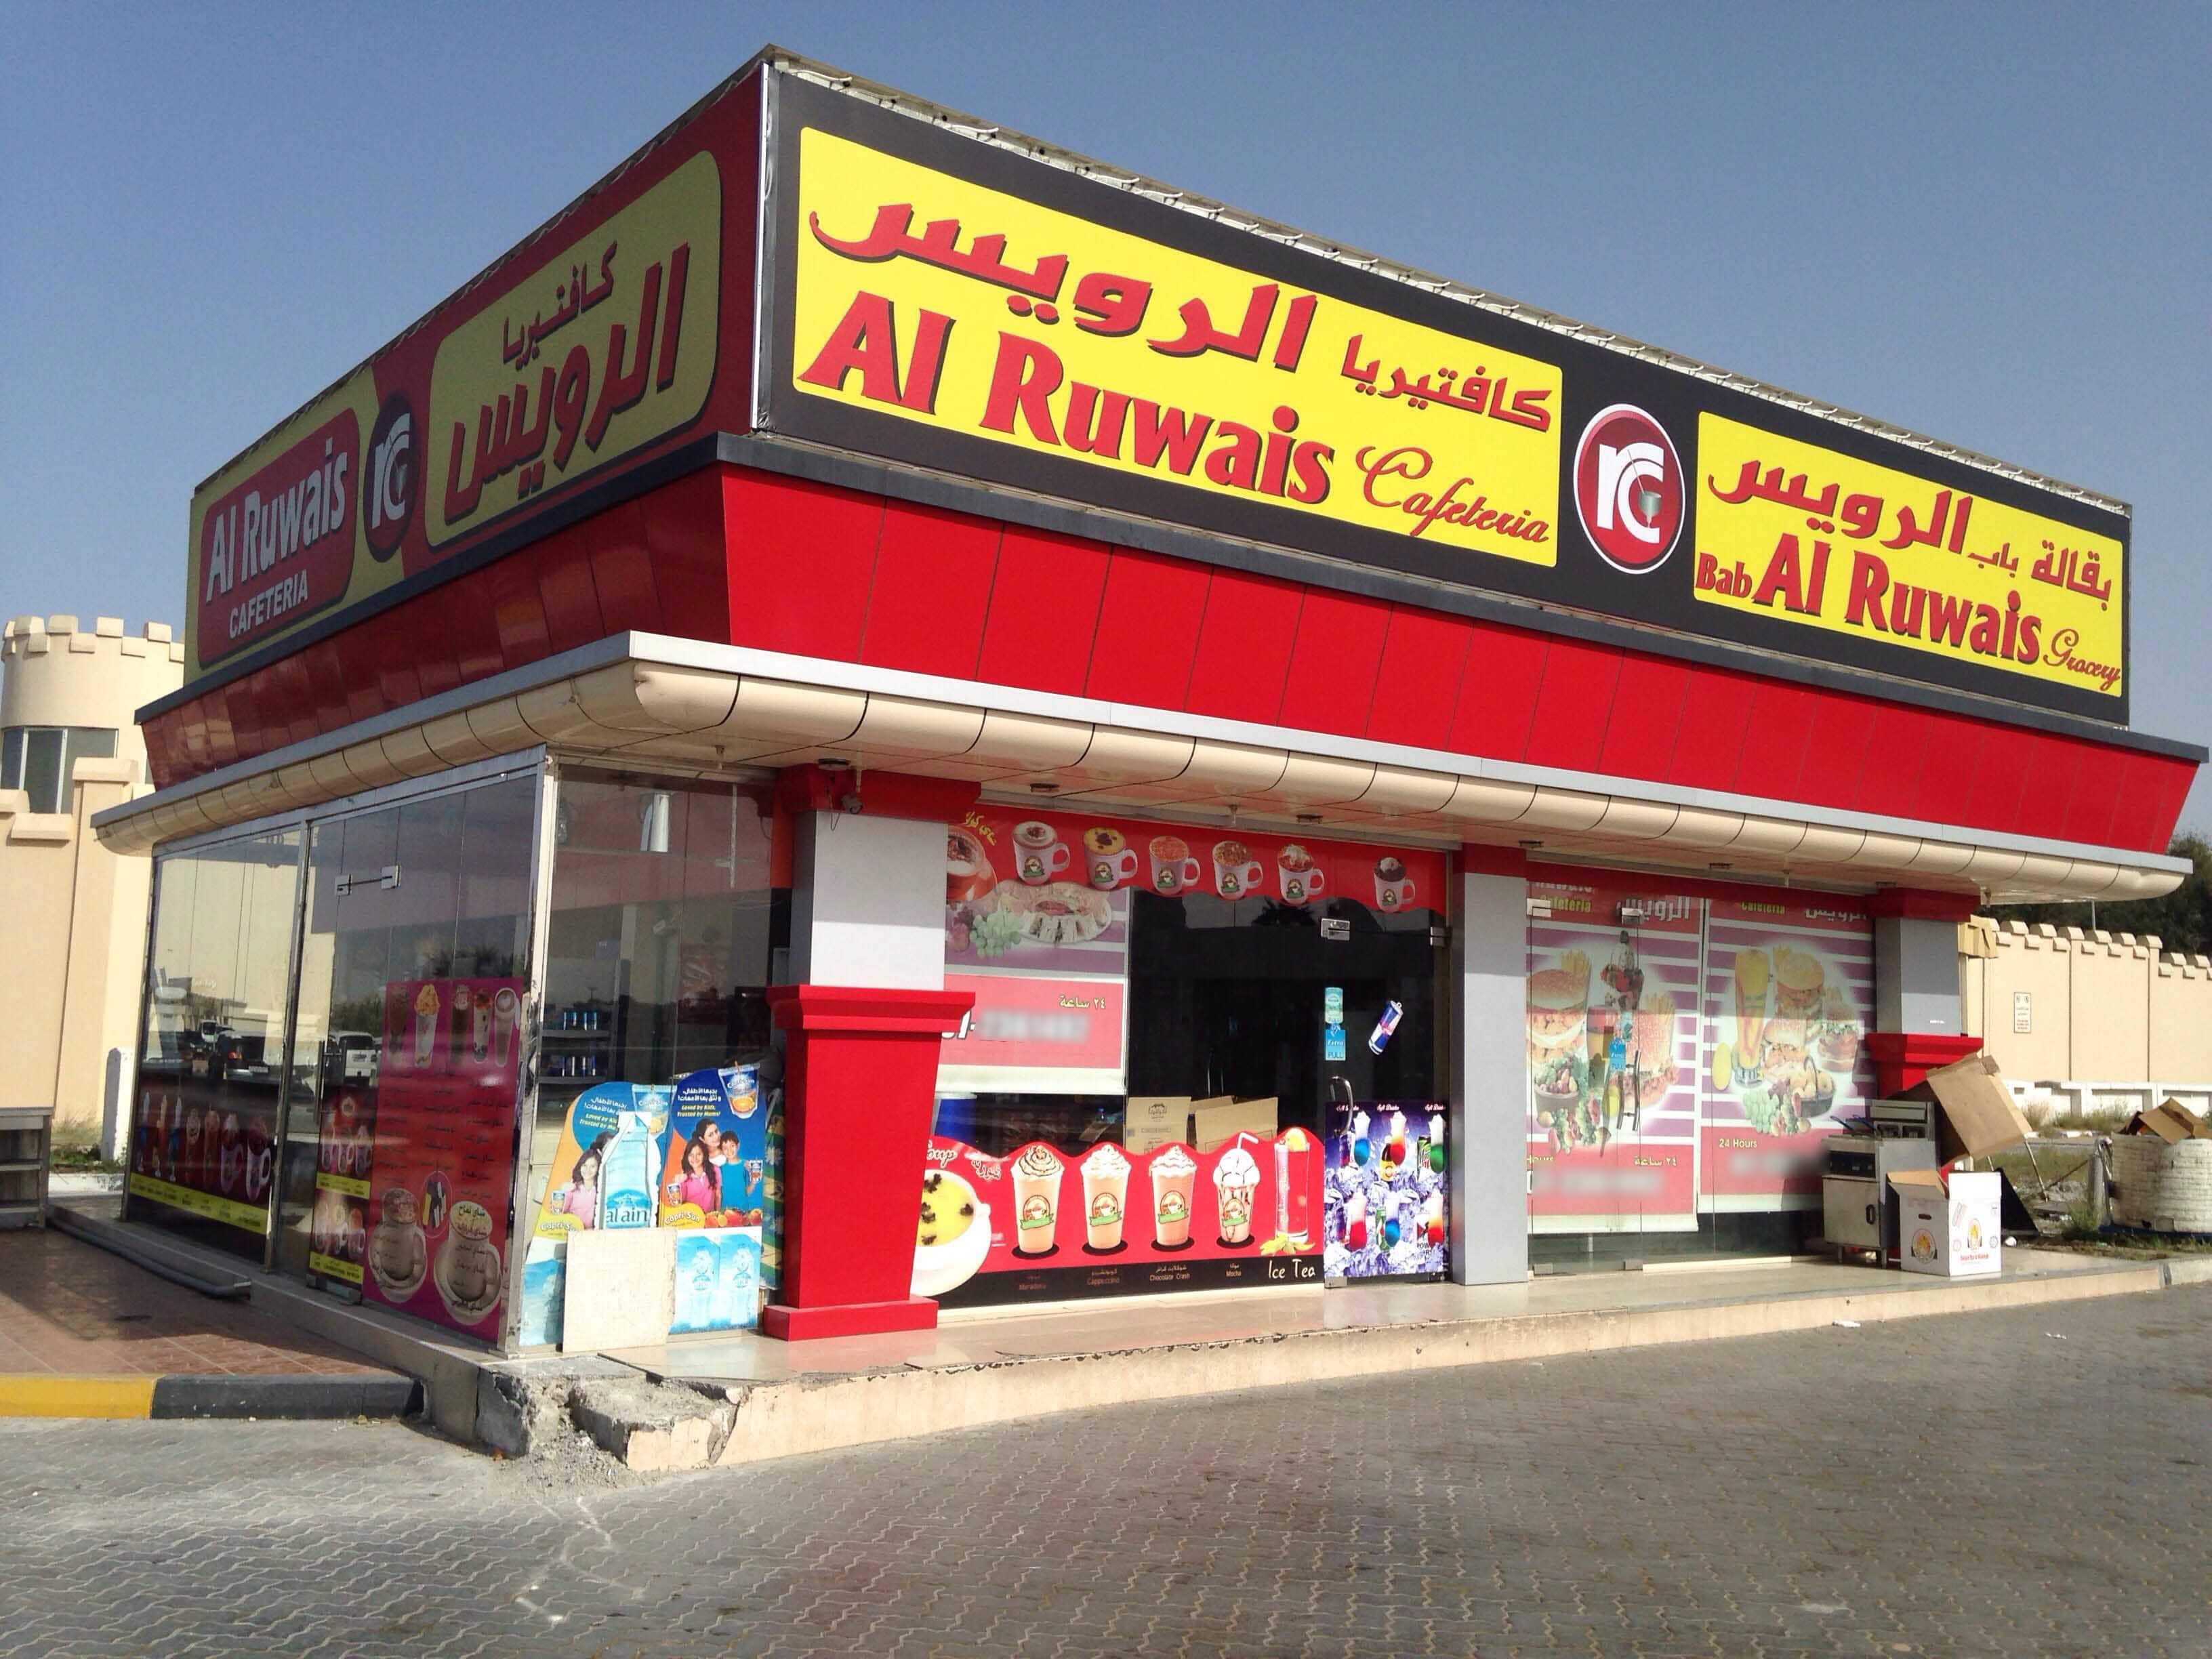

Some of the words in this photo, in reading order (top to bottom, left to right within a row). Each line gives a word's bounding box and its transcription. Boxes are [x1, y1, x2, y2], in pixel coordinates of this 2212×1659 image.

[502, 240, 617, 371] كافتيريا
[810, 203, 1317, 371] الرويس
[444, 239, 689, 526] الرويس
[797, 290, 956, 415] Al
[979, 331, 1334, 504] Ruwais
[1355, 446, 1549, 542] Cafeteria
[1341, 334, 1552, 432] كافتيريا
[206, 505, 236, 602] Al
[242, 438, 347, 583] Ruwais
[1708, 459, 1973, 554] الرويس
[229, 569, 308, 639] CAFETERIA
[1696, 552, 1752, 598] Bab
[1752, 533, 1830, 616] Al
[1845, 550, 2042, 664] Ruwais
[1968, 543, 2019, 577] باب
[2031, 540, 2112, 611] بقالة
[1719, 1138, 1730, 1149] 24
[1733, 1138, 1757, 1149] Hours
[1269, 1260, 1285, 1279] Ice
[1292, 1258, 1315, 1278] Tea
